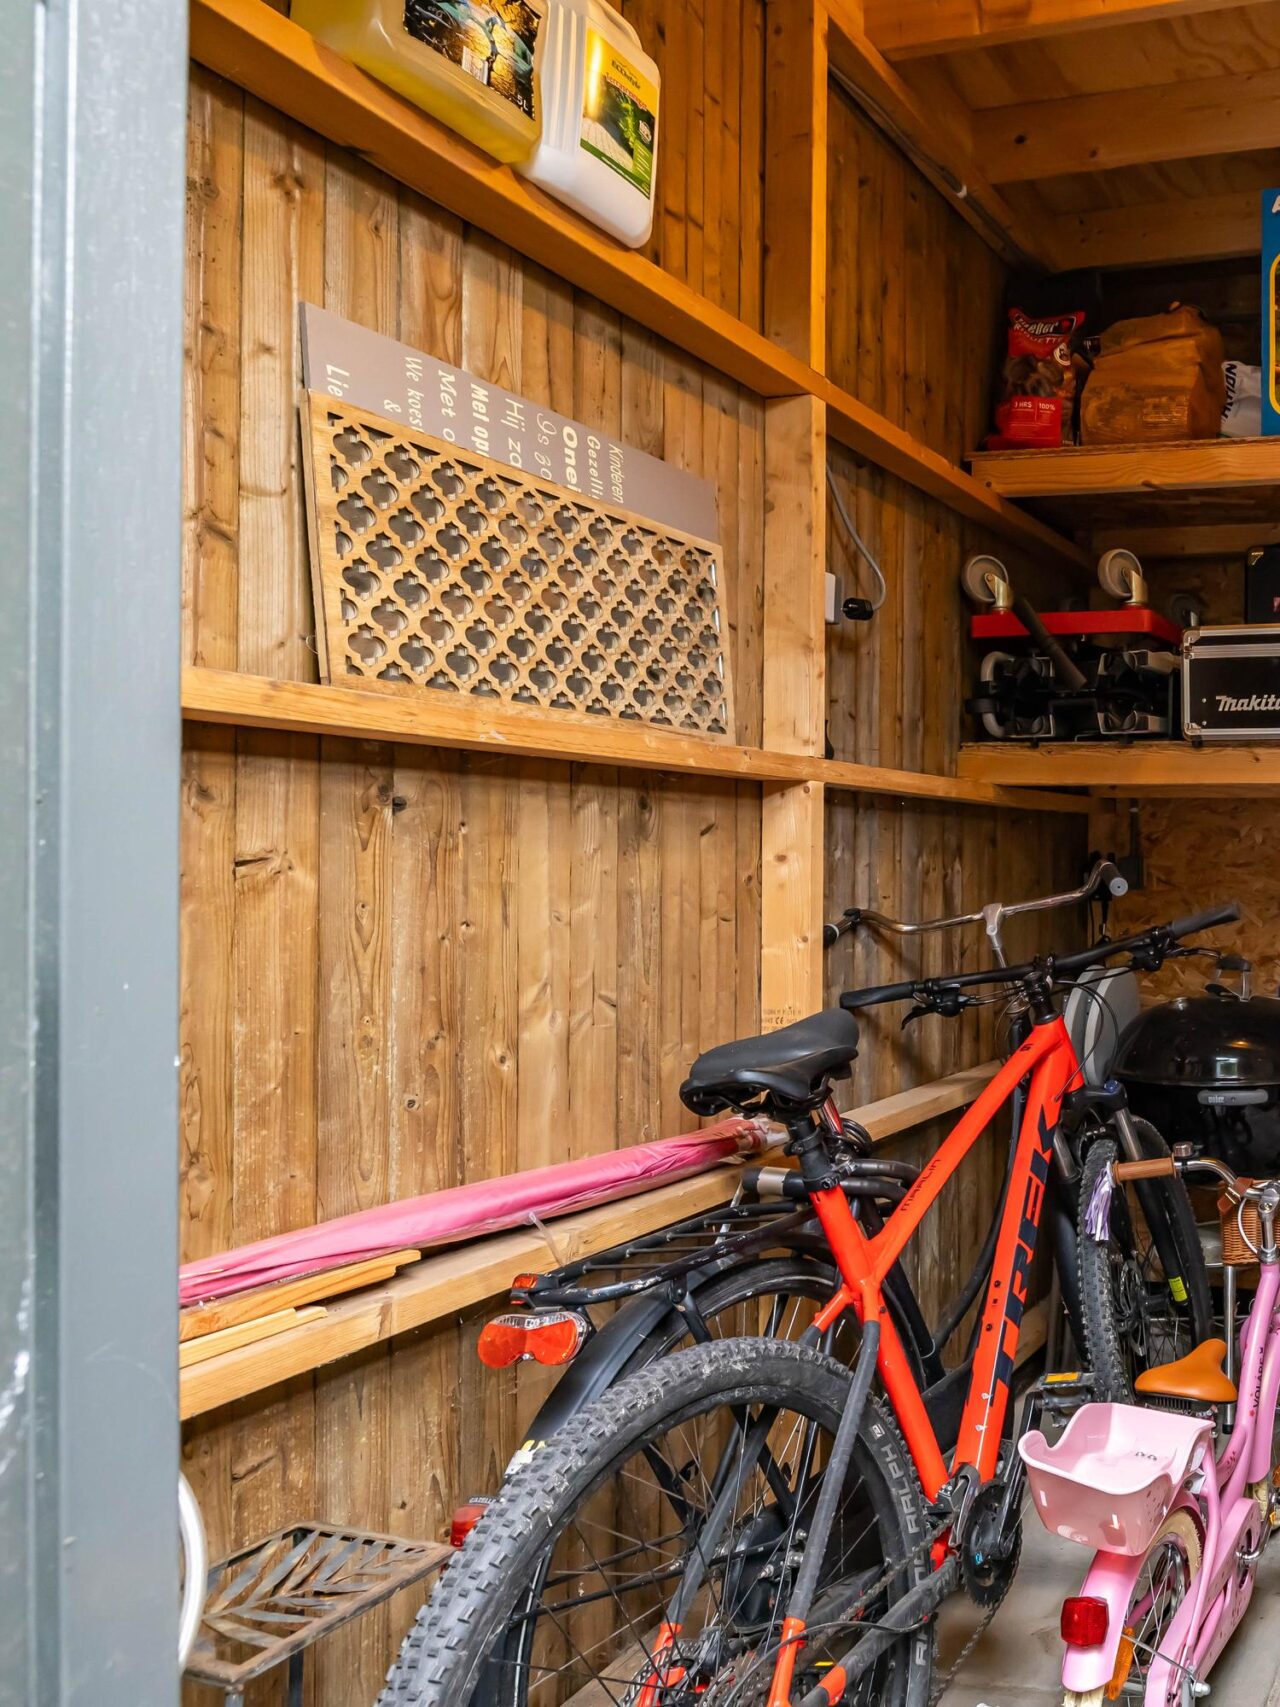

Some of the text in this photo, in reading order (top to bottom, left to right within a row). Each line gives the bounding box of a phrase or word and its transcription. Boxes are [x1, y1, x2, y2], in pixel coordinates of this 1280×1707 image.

[405, 356, 423, 382] We
[438, 370, 457, 417] Met
[384, 399, 402, 413] &
[608, 443, 625, 504] Kinderen
[988, 1104, 1056, 1406] TREK
[881, 1443, 920, 1534] RALPH
